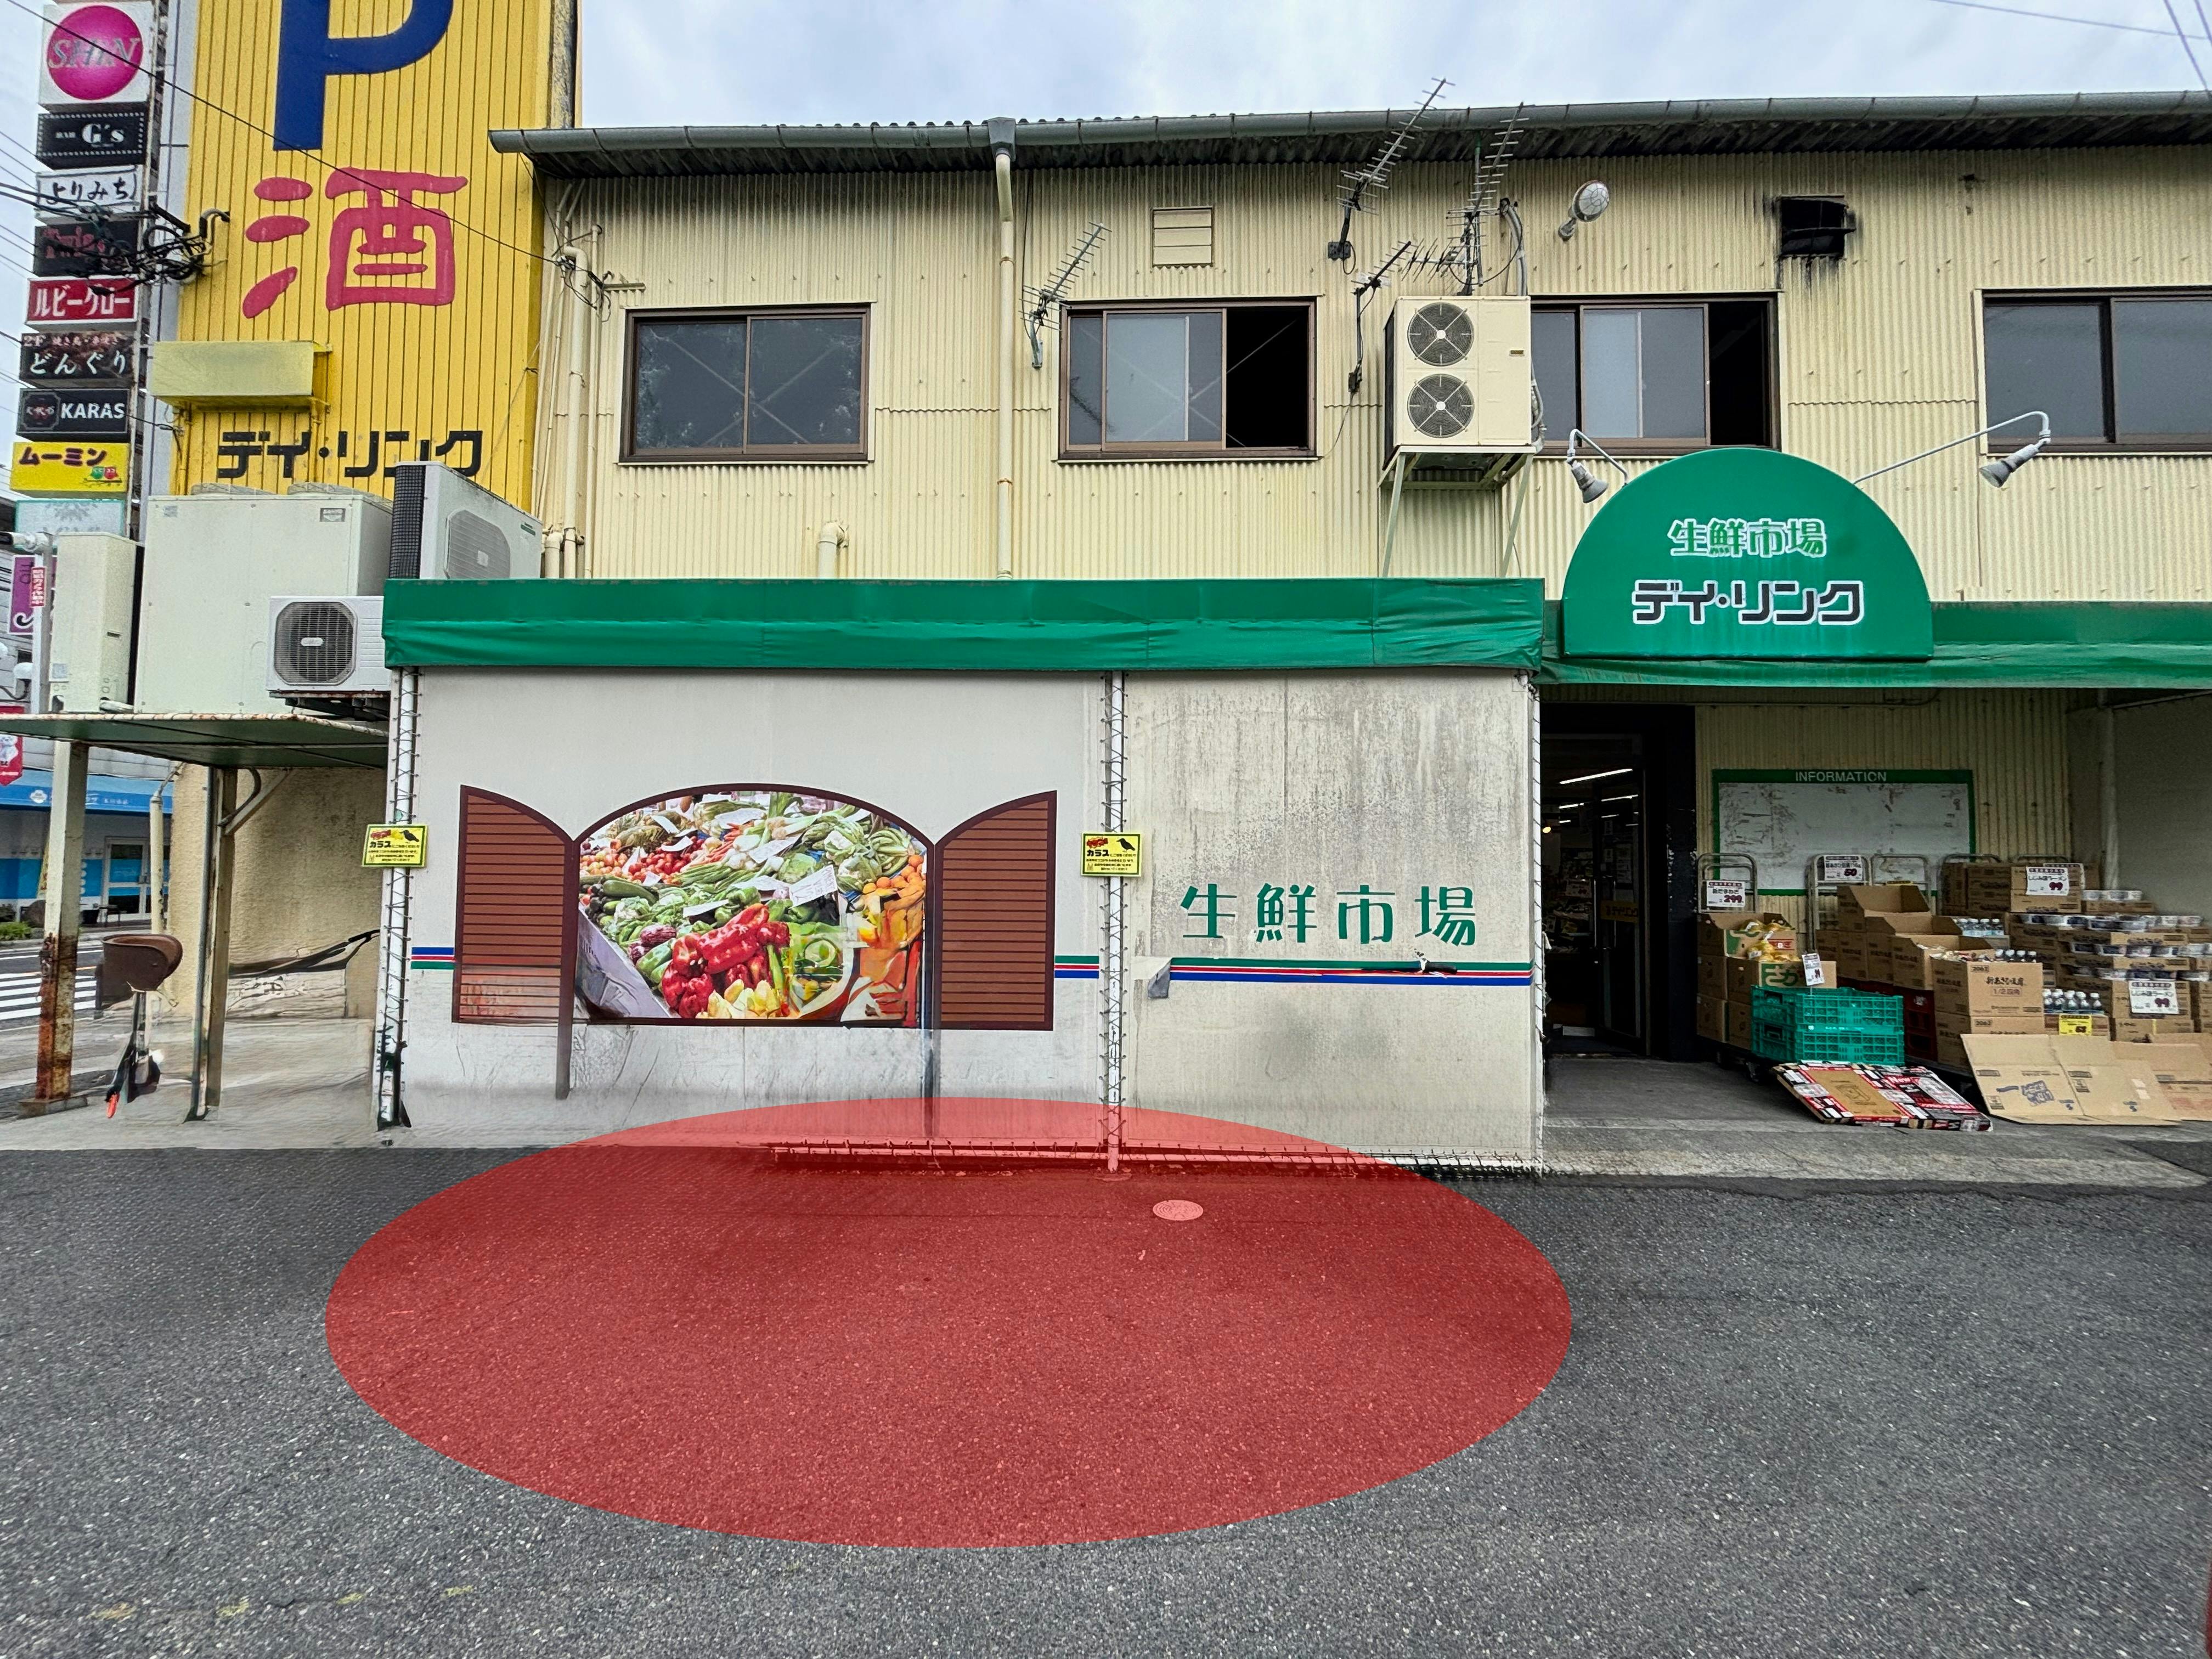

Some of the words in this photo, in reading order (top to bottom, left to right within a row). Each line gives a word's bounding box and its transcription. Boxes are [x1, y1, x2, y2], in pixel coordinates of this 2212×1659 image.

[243, 167, 468, 319] 酒
[30, 350, 126, 375] どんぐり
[61, 403, 125, 419] KARAS
[18, 447, 107, 466] ムーミン
[1668, 518, 1827, 557] 生鮮市場
[1632, 579, 1864, 625] デイ・リンク
[1796, 771, 1887, 782] INFORMATION
[1181, 883, 1476, 947] 生鮮市場
